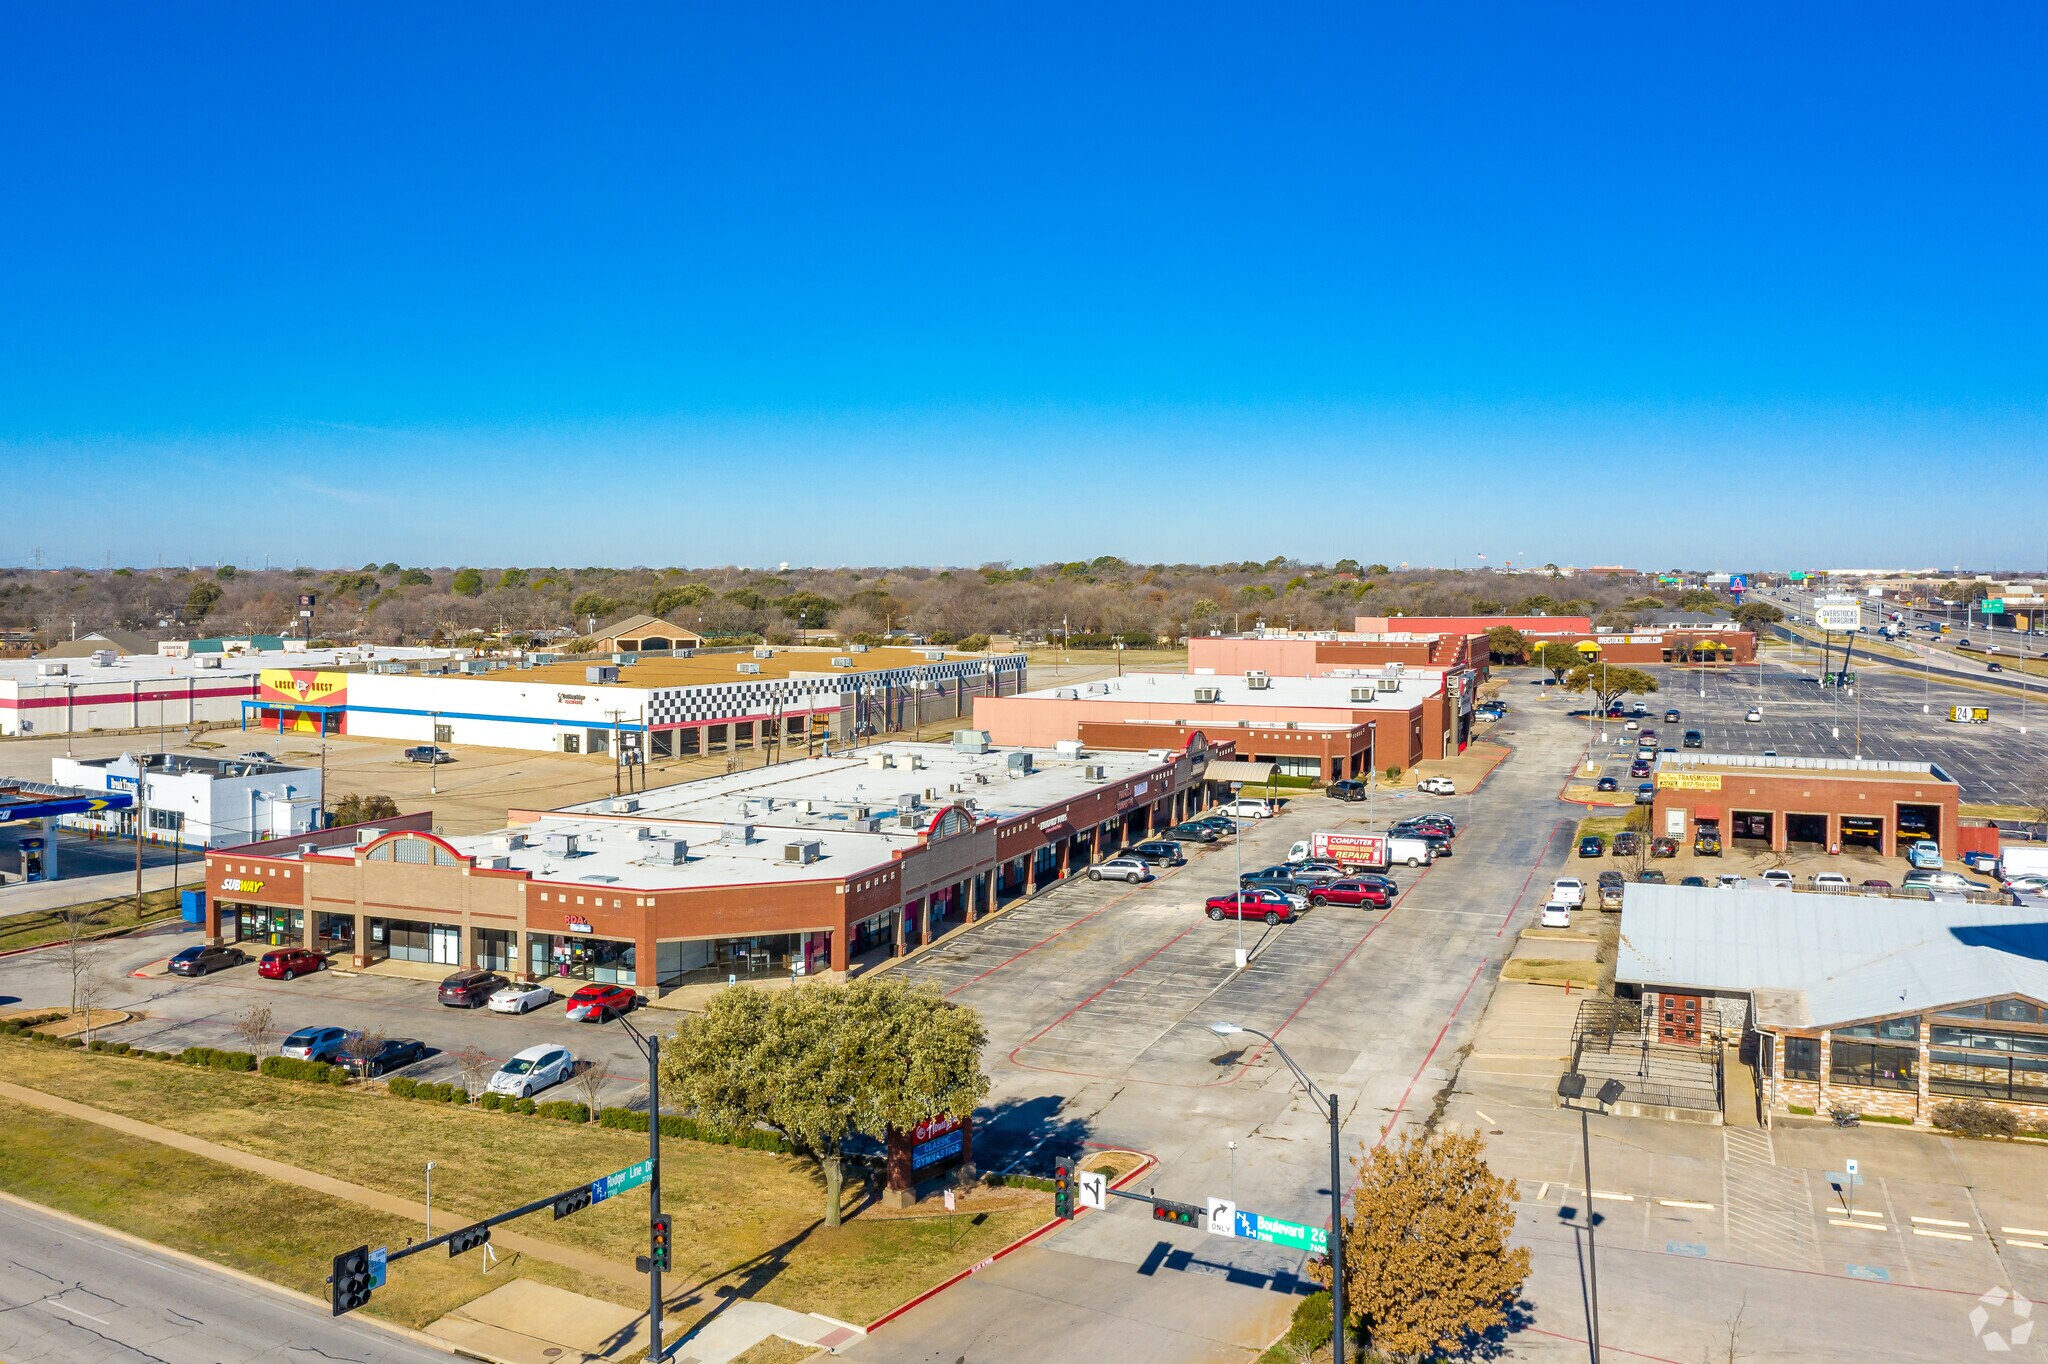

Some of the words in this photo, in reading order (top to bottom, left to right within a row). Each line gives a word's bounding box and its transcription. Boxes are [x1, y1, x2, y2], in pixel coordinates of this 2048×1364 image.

[312, 682, 333, 692] QUEST
[1957, 707, 1968, 720] 24
[1678, 774, 1720, 782] TRANSMISSION
[1330, 837, 1373, 846] COMPUTER
[1335, 851, 1370, 860] REPAIR
[221, 878, 265, 893] SUBWAY
[924, 1136, 951, 1153] CLASSIC
[915, 1144, 960, 1168] GYMNASTICS
[606, 1171, 627, 1188] Rodger
[629, 1166, 642, 1179] Line
[645, 1160, 653, 1173] Dr
[1211, 1222, 1231, 1233] ONLY
[1257, 1216, 1305, 1239] Boulevard
[1311, 1228, 1327, 1243] 26
[1309, 1243, 1326, 1254] 7600
